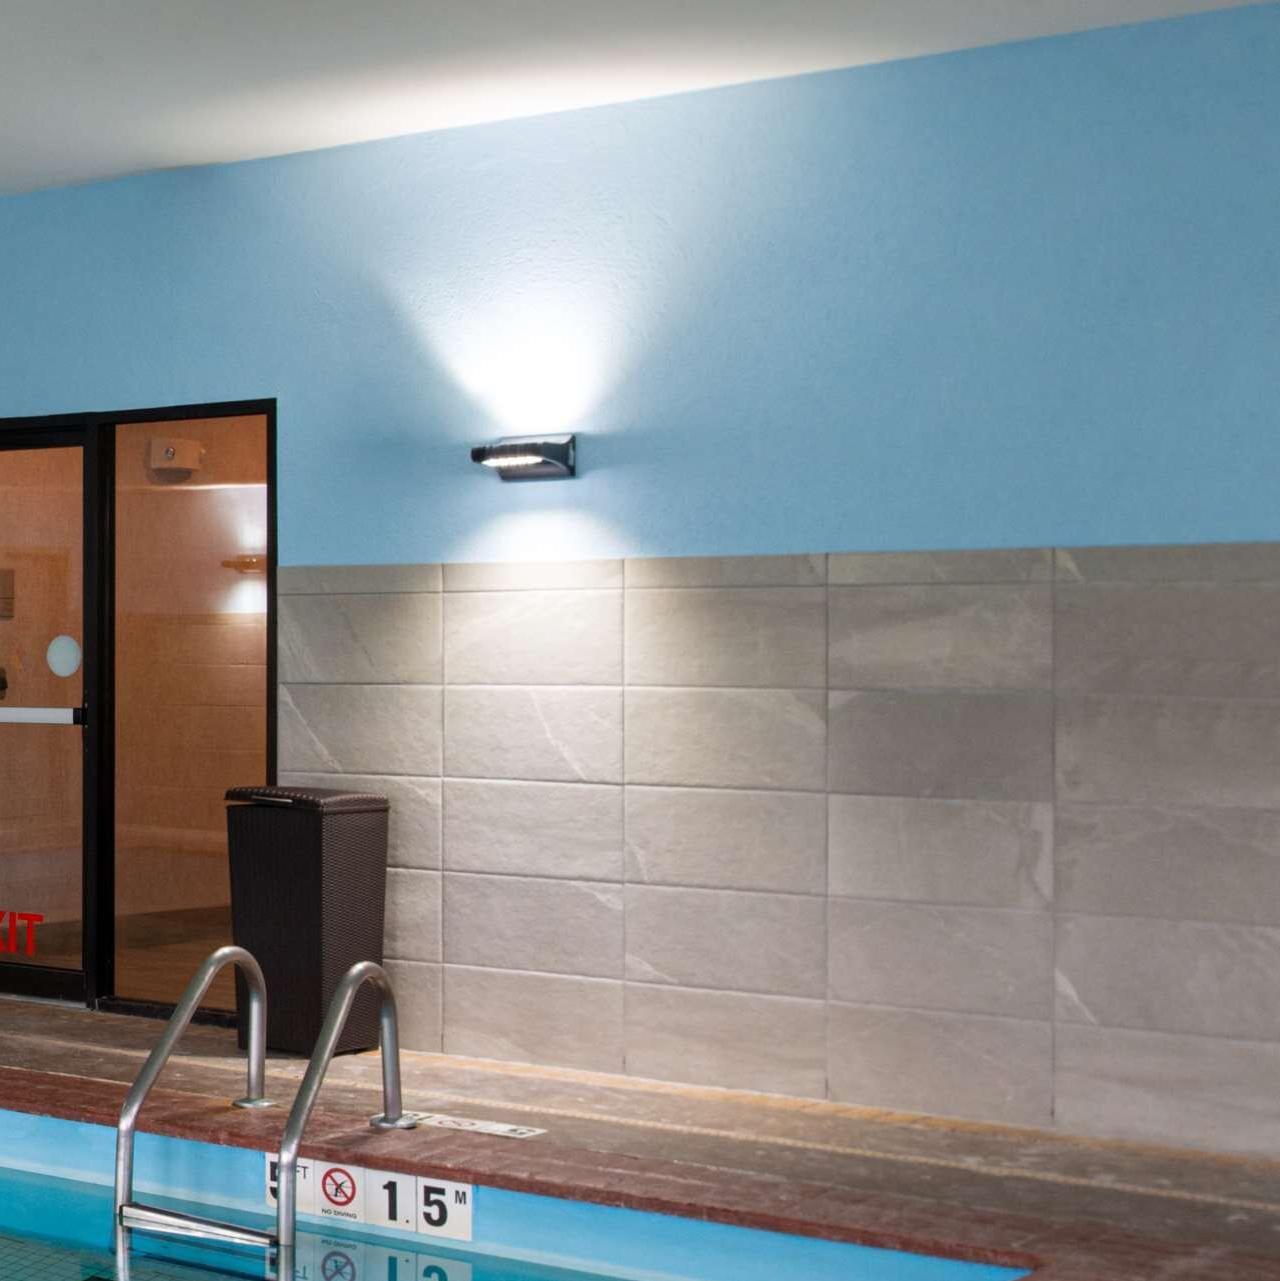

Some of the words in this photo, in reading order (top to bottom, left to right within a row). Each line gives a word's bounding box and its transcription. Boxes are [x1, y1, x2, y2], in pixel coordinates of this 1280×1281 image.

[454, 1190, 467, 1205] M
[321, 1208, 332, 1216] NO
[333, 1209, 357, 1220] DIVING
